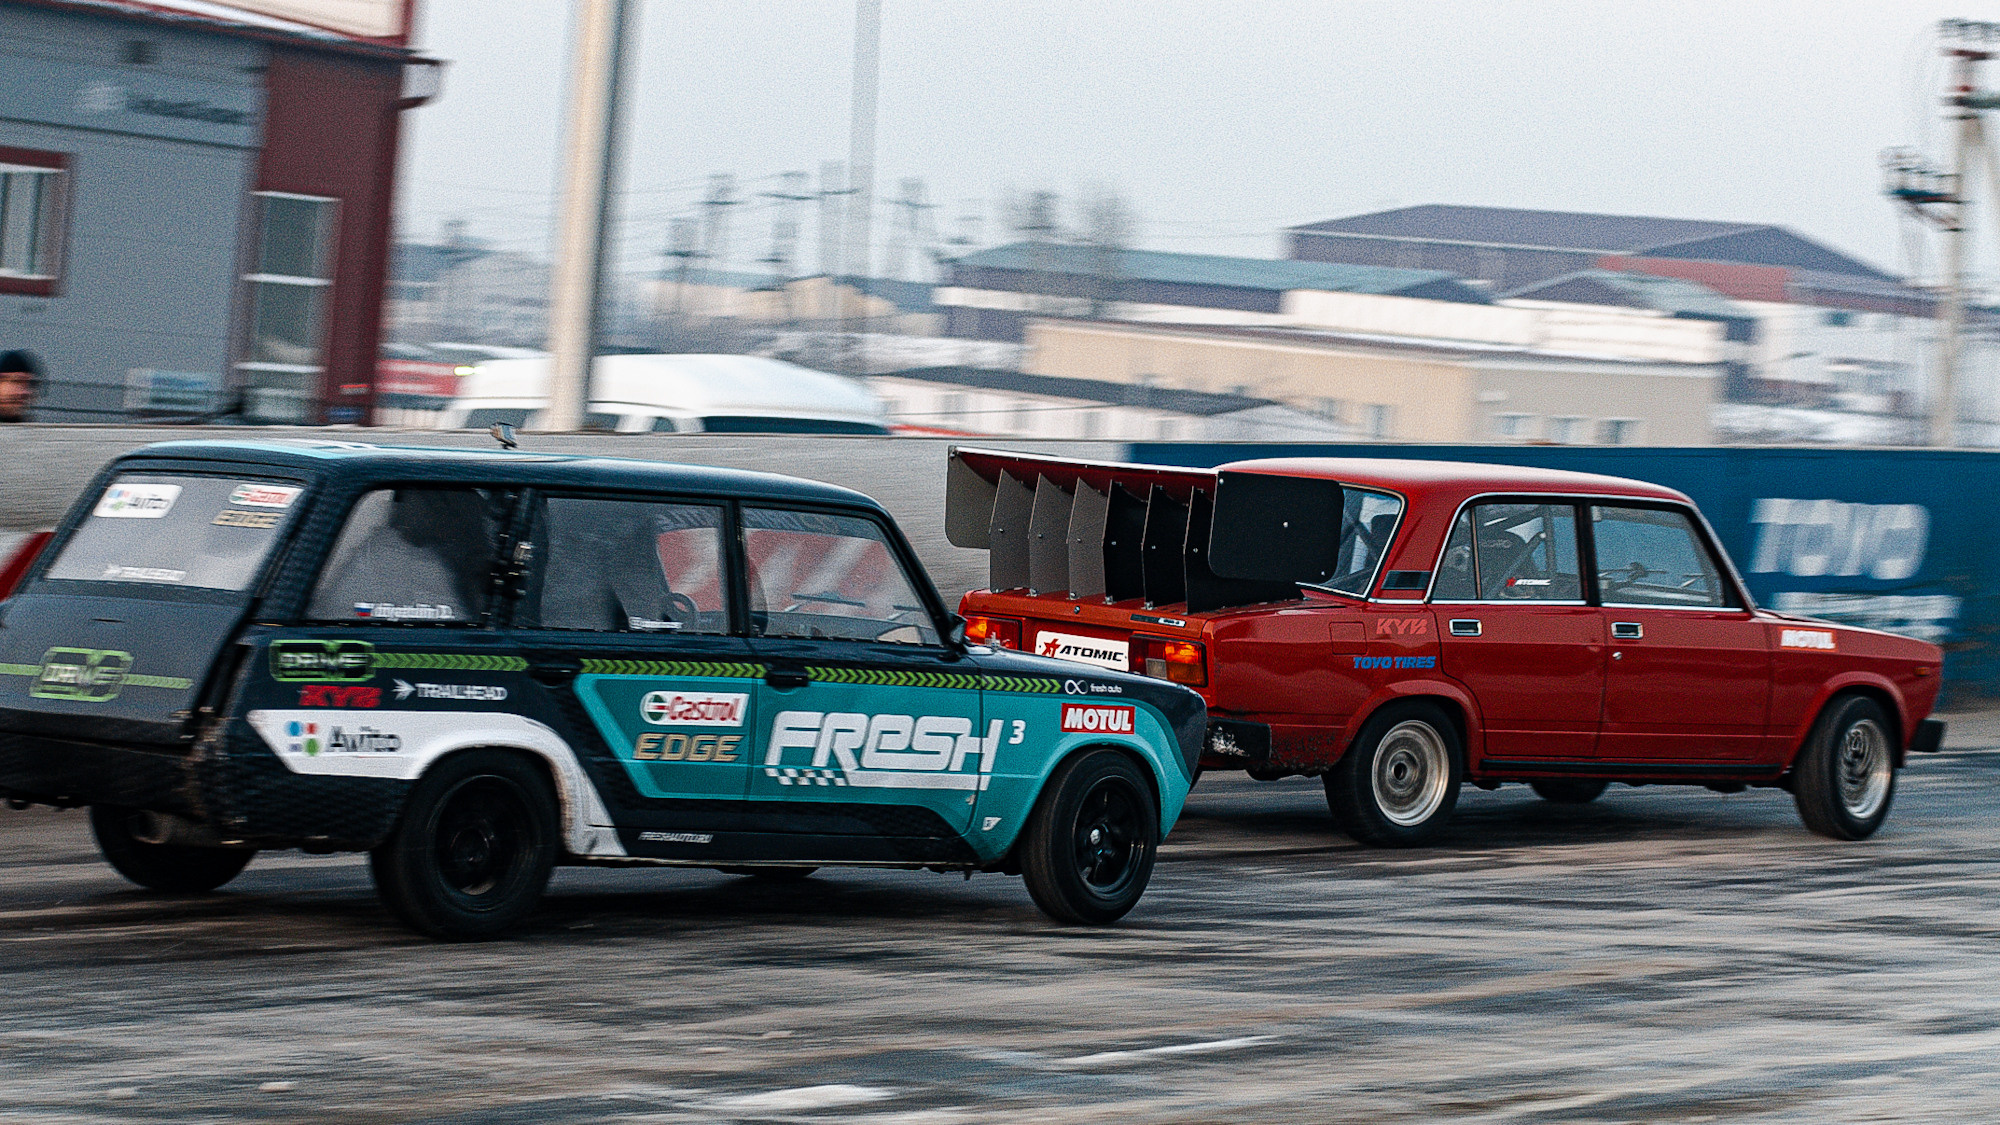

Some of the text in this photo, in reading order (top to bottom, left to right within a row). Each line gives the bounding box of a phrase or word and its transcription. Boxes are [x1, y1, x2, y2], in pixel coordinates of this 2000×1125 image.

[1376, 618, 1428, 634] KYB
[1060, 645, 1124, 662] ATOMIC
[1353, 656, 1436, 669] TOYO TIRES
[299, 685, 383, 708] KYB
[415, 683, 508, 700] TRAILHEAD
[1090, 683, 1123, 694] fresh auto
[668, 695, 741, 721] Castrol
[1063, 707, 1132, 731] MOTUL
[325, 725, 402, 753] Avito
[1008, 719, 1026, 745] 3
[633, 732, 744, 763] EDGE
